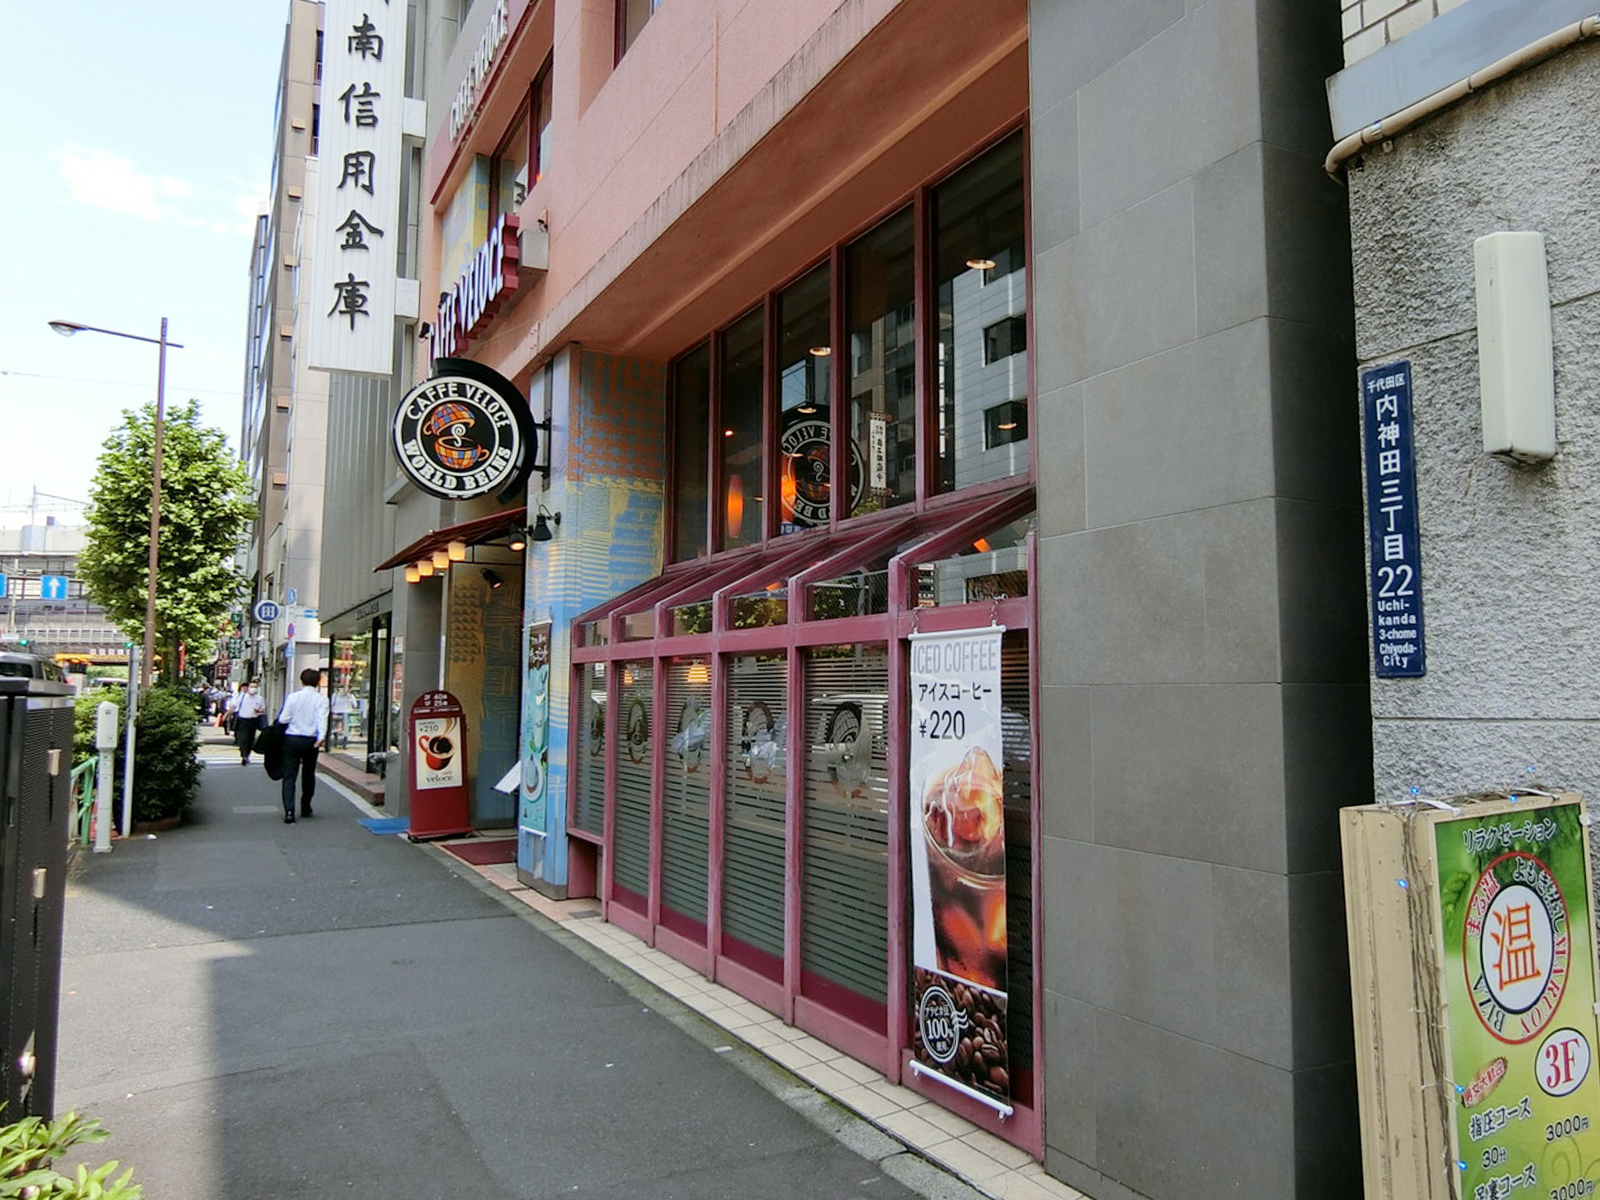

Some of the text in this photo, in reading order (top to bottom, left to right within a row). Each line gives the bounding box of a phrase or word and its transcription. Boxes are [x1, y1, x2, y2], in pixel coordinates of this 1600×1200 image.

[327, 0, 389, 331] 南信用金庫
[1366, 373, 1406, 394] 千代田区
[466, 384, 511, 429] VELOCE
[403, 438, 512, 490] WORLD BEANS
[1375, 394, 1405, 562] 内神田三丁目
[1377, 564, 1414, 598] 22
[1377, 599, 1410, 611] Uchi-
[1378, 613, 1416, 626] kanda
[1379, 628, 1417, 640] 3-chome
[1379, 642, 1417, 656] Chiyoda-
[913, 639, 998, 675] ICED COFFEE
[1383, 655, 1408, 668] City
[918, 681, 993, 703] アイスコーヒー
[918, 710, 966, 741] ¥220
[1463, 817, 1558, 853] リラクゼーション
[1466, 868, 1501, 937] まる温
[1490, 900, 1542, 992] 温
[1545, 1037, 1581, 1090] 3F
[1470, 1096, 1533, 1141] 指圧コース
[1546, 1115, 1590, 1142] 3000円
[1482, 1146, 1508, 1169] 30分
